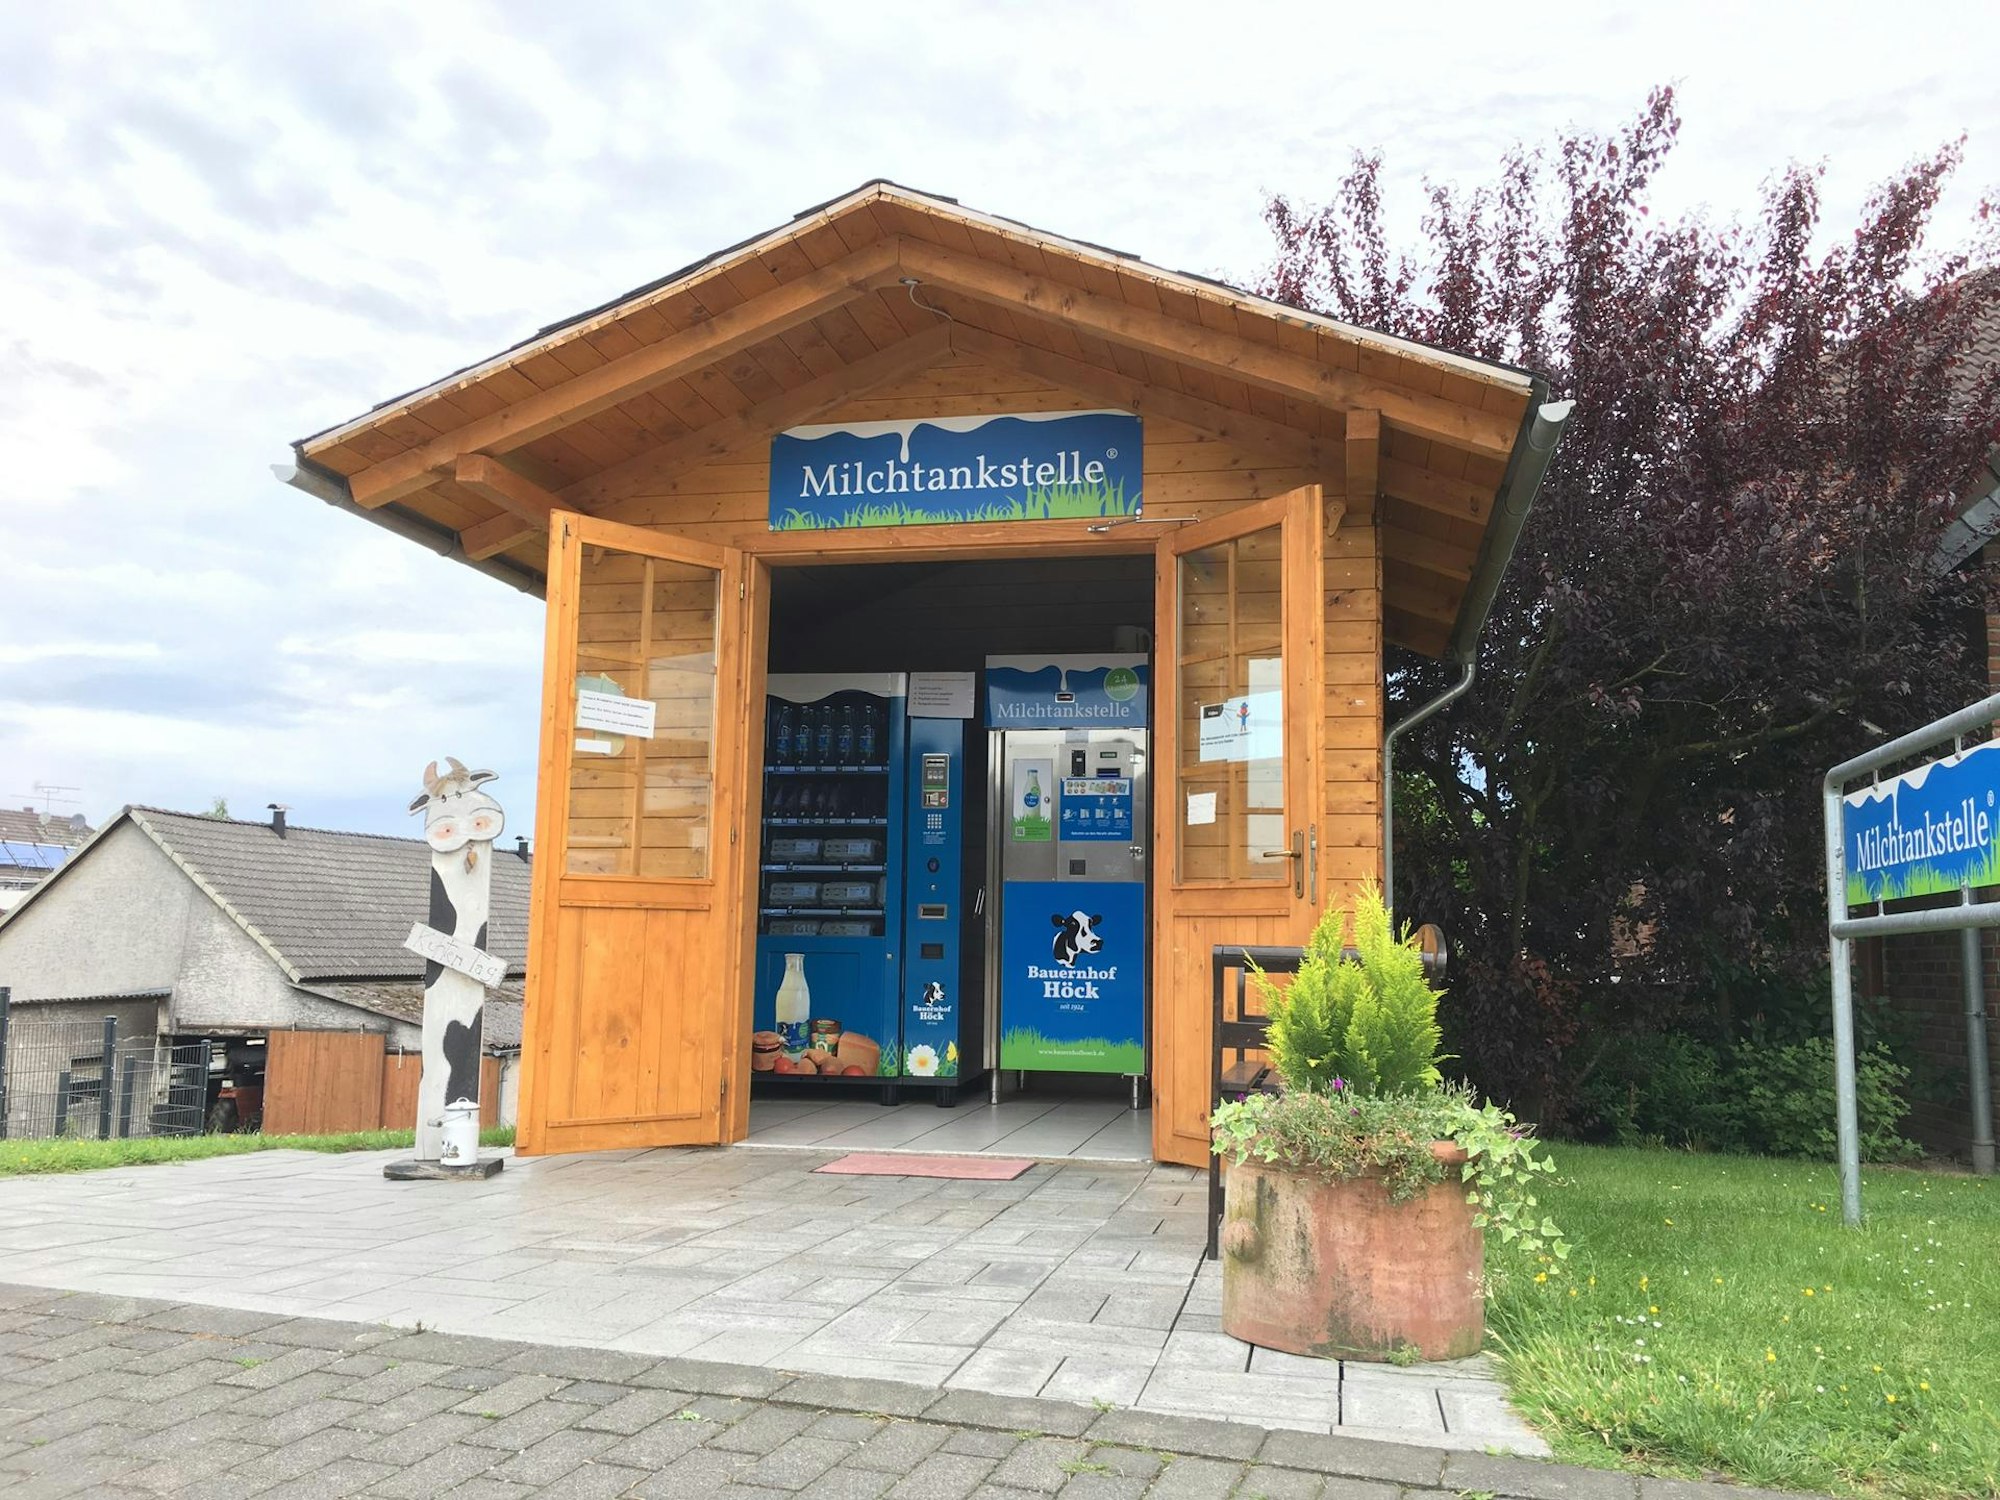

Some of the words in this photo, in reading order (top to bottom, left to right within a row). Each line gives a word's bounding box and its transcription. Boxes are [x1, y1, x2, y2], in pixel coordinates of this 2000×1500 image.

[997, 702, 1130, 718] Milchtankstelle
[469, 947, 499, 982] Tag
[1027, 966, 1117, 980] Bauernhof
[1043, 981, 1100, 999] Höck
[912, 1004, 952, 1013] Bauernhof
[919, 1012, 945, 1021] Höck
